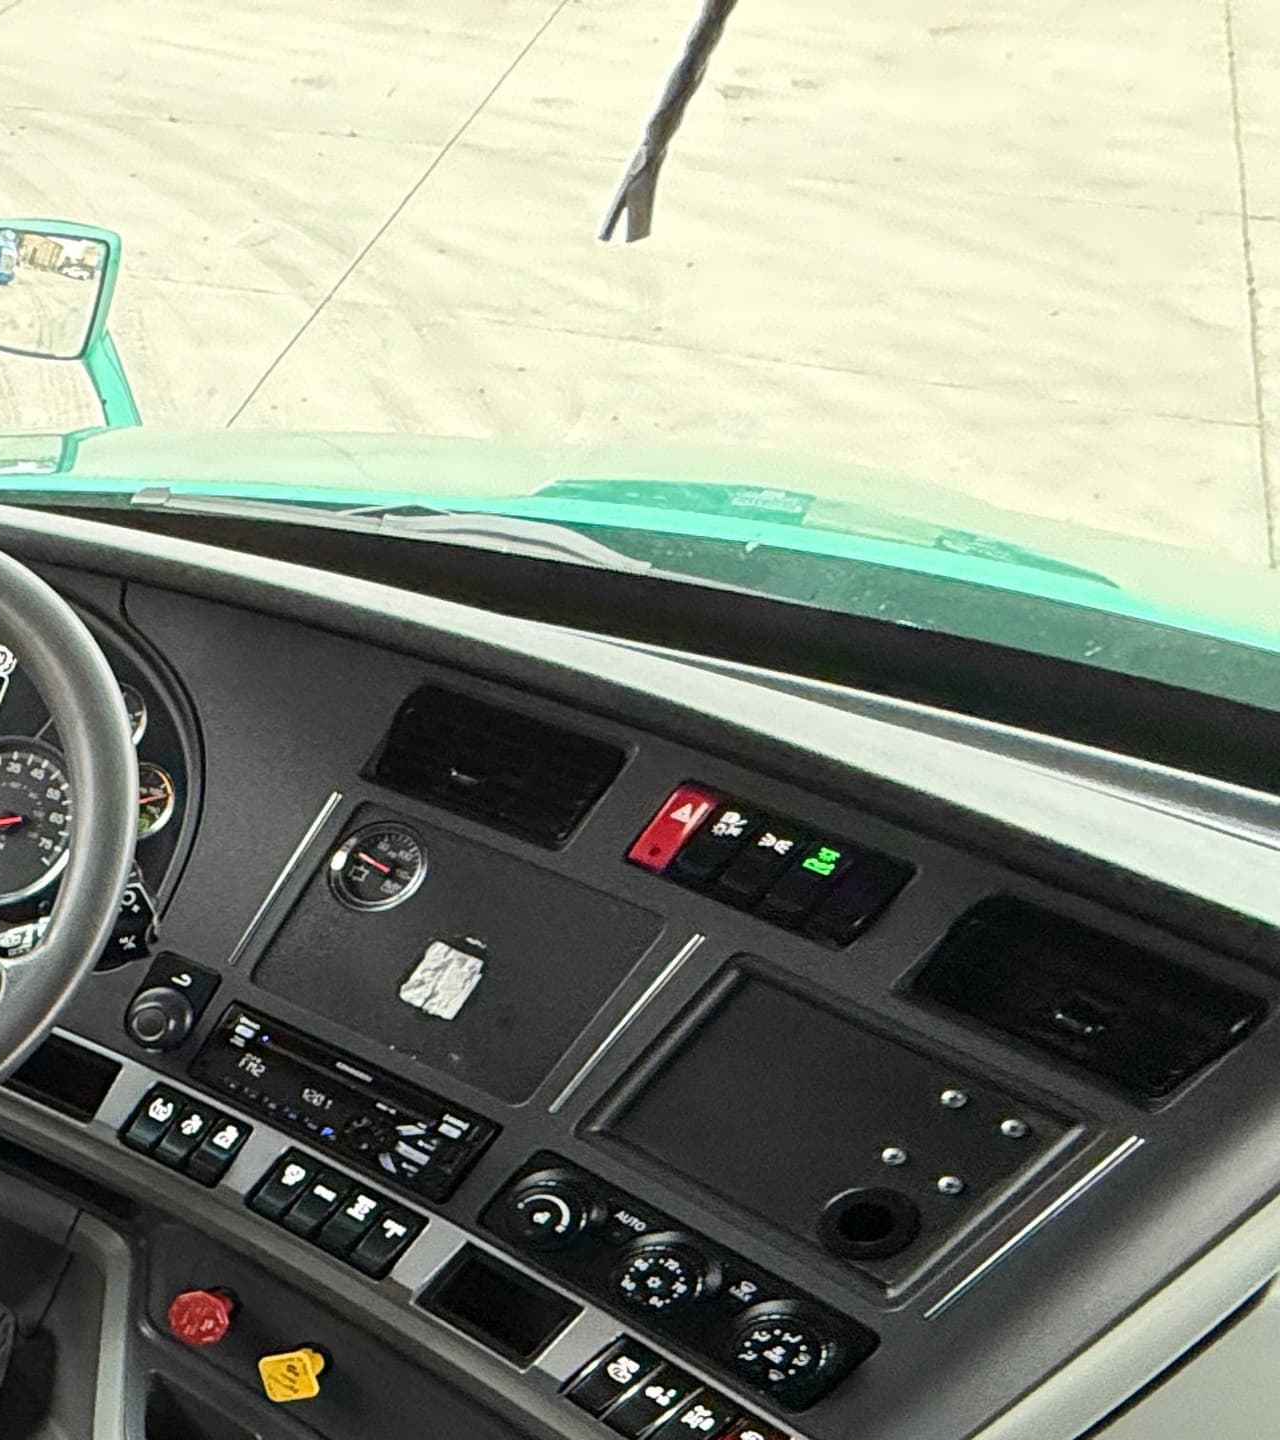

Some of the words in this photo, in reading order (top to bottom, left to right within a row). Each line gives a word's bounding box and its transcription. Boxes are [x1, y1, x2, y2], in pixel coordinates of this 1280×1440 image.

[6, 762, 21, 774] 35
[30, 768, 45, 780] 45
[614, 1209, 647, 1232] AUTO
